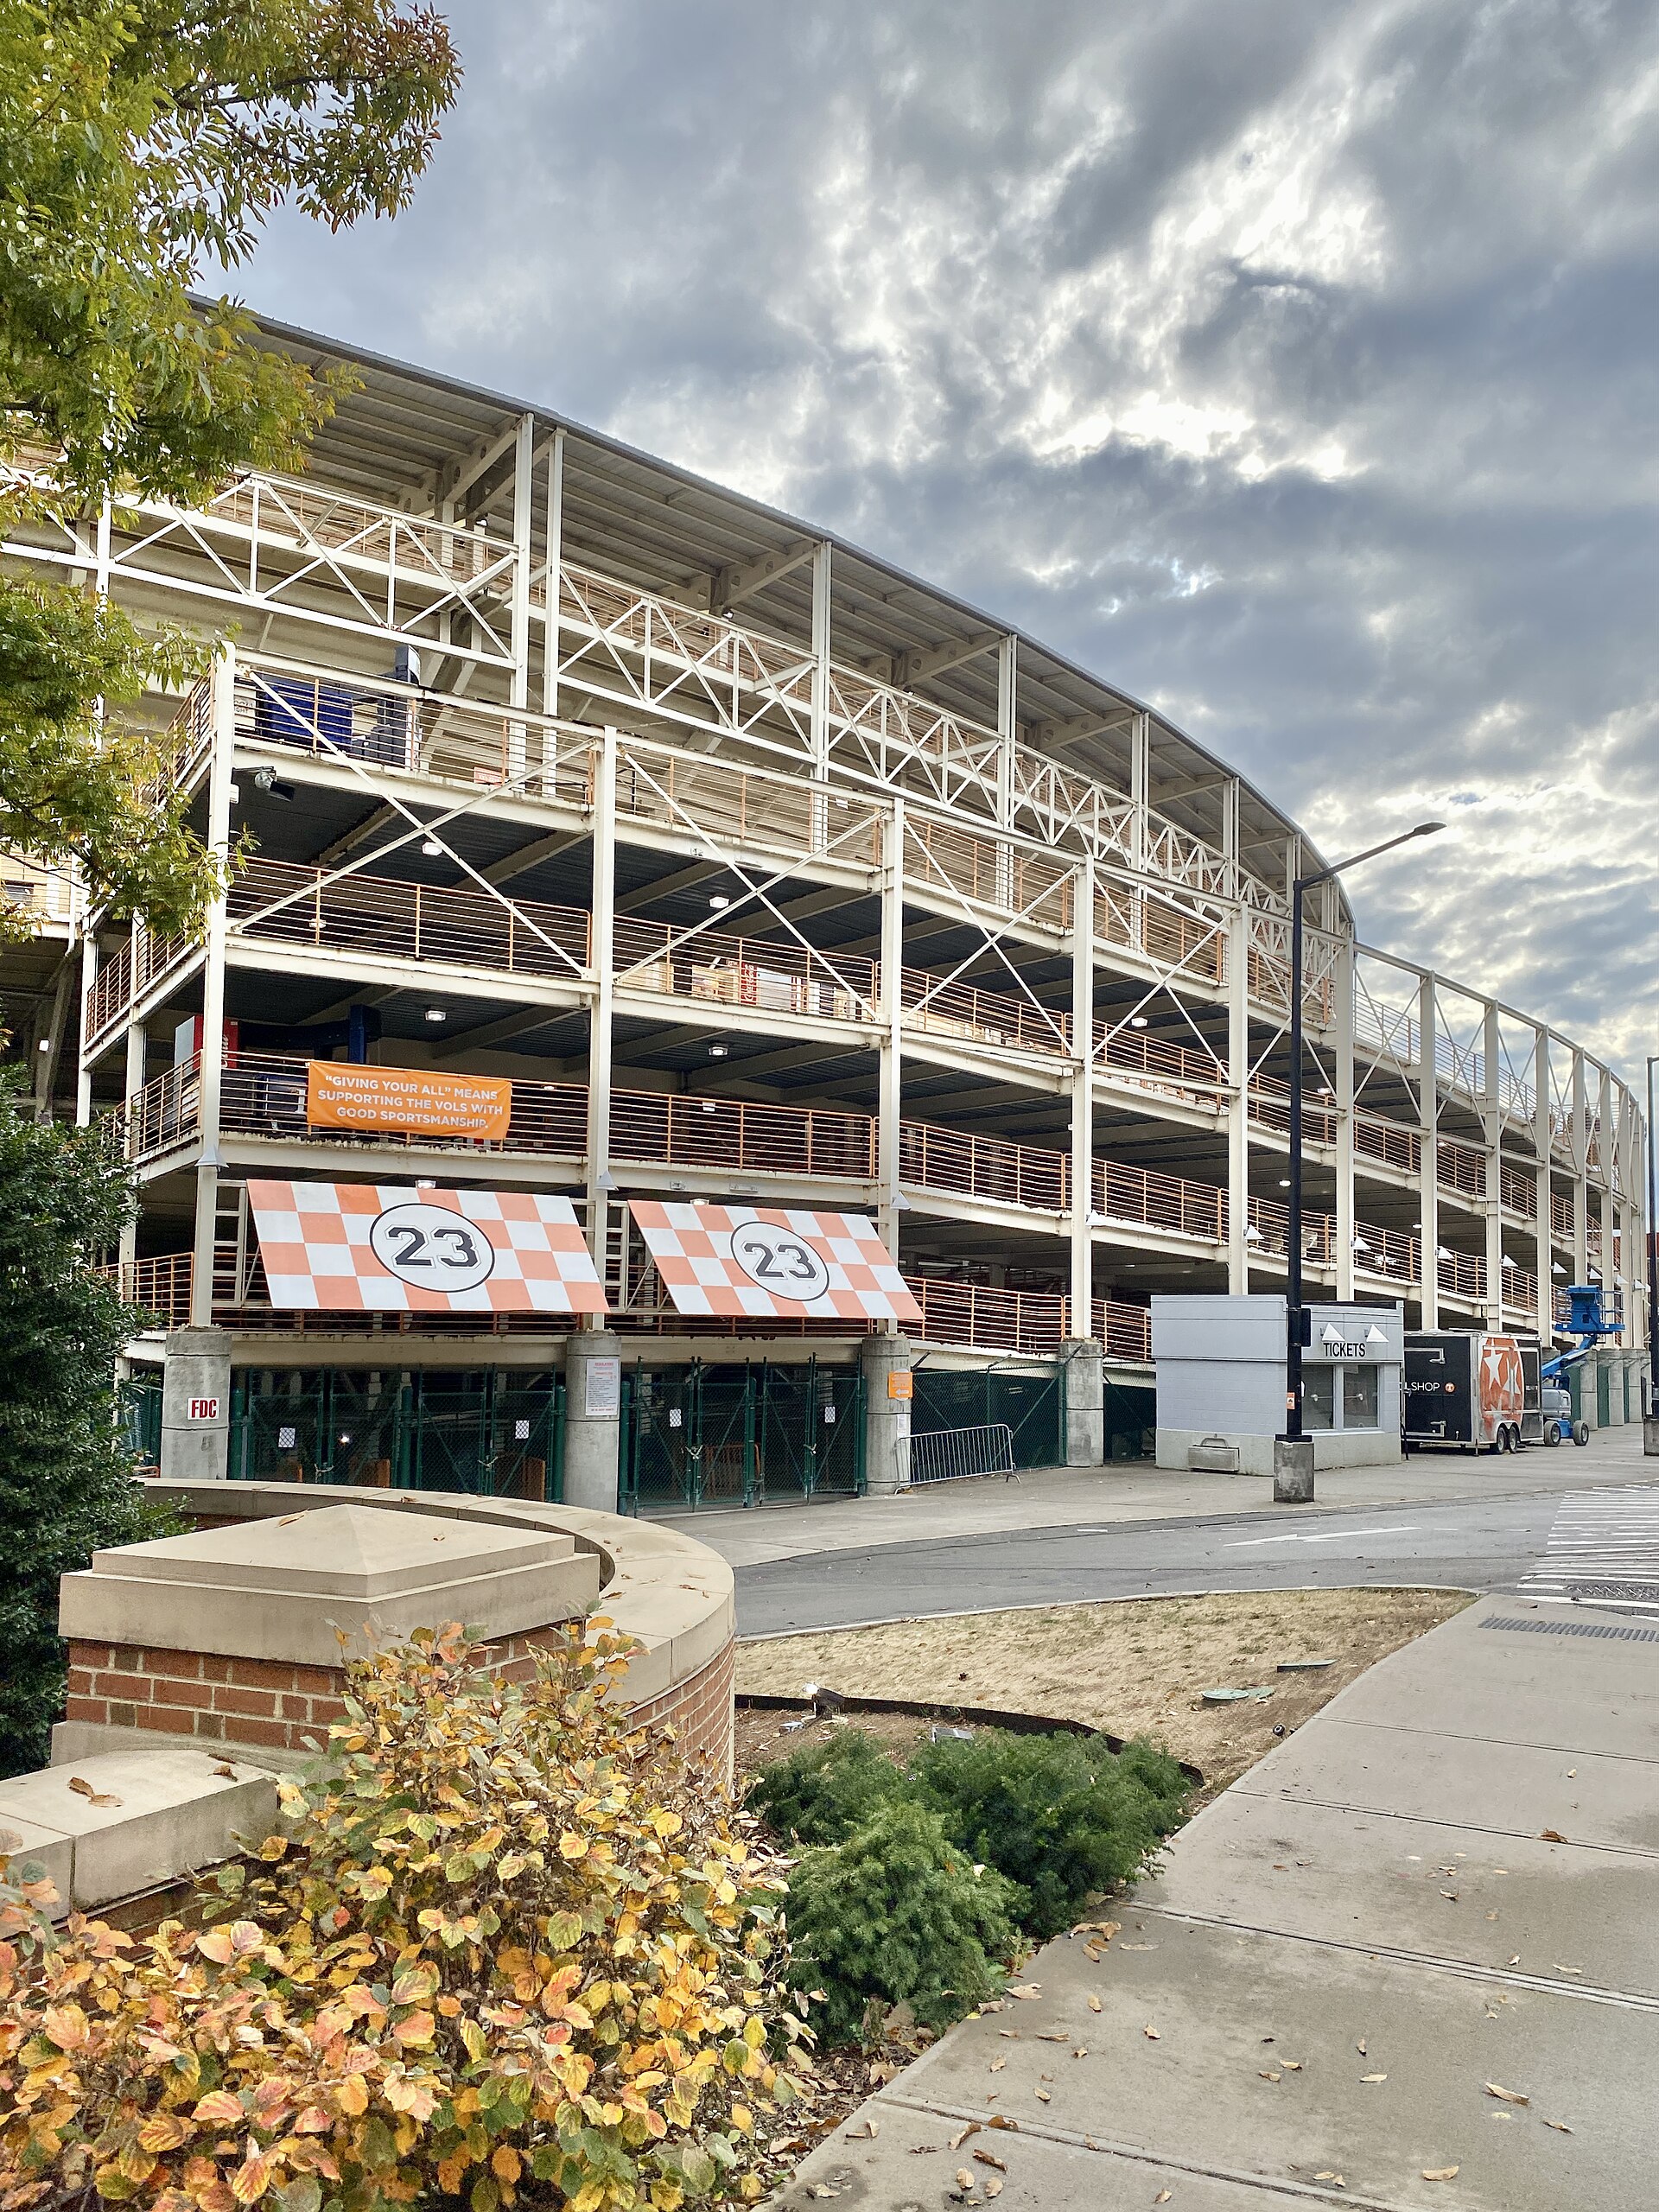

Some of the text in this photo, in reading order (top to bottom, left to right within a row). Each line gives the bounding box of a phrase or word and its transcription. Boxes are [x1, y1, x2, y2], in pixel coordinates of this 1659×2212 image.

[382, 1081, 418, 1094] YOUR
[454, 1087, 498, 1100] MEANS
[317, 1089, 503, 1116] SUPPORTING THE VOLS WITH
[336, 1106, 489, 1128] GOOD SPORTSMANSHIP.
[385, 1225, 480, 1268] 23
[742, 1242, 818, 1280] 23
[1323, 1343, 1366, 1357] TICKETS
[191, 1399, 217, 1418] FDC
